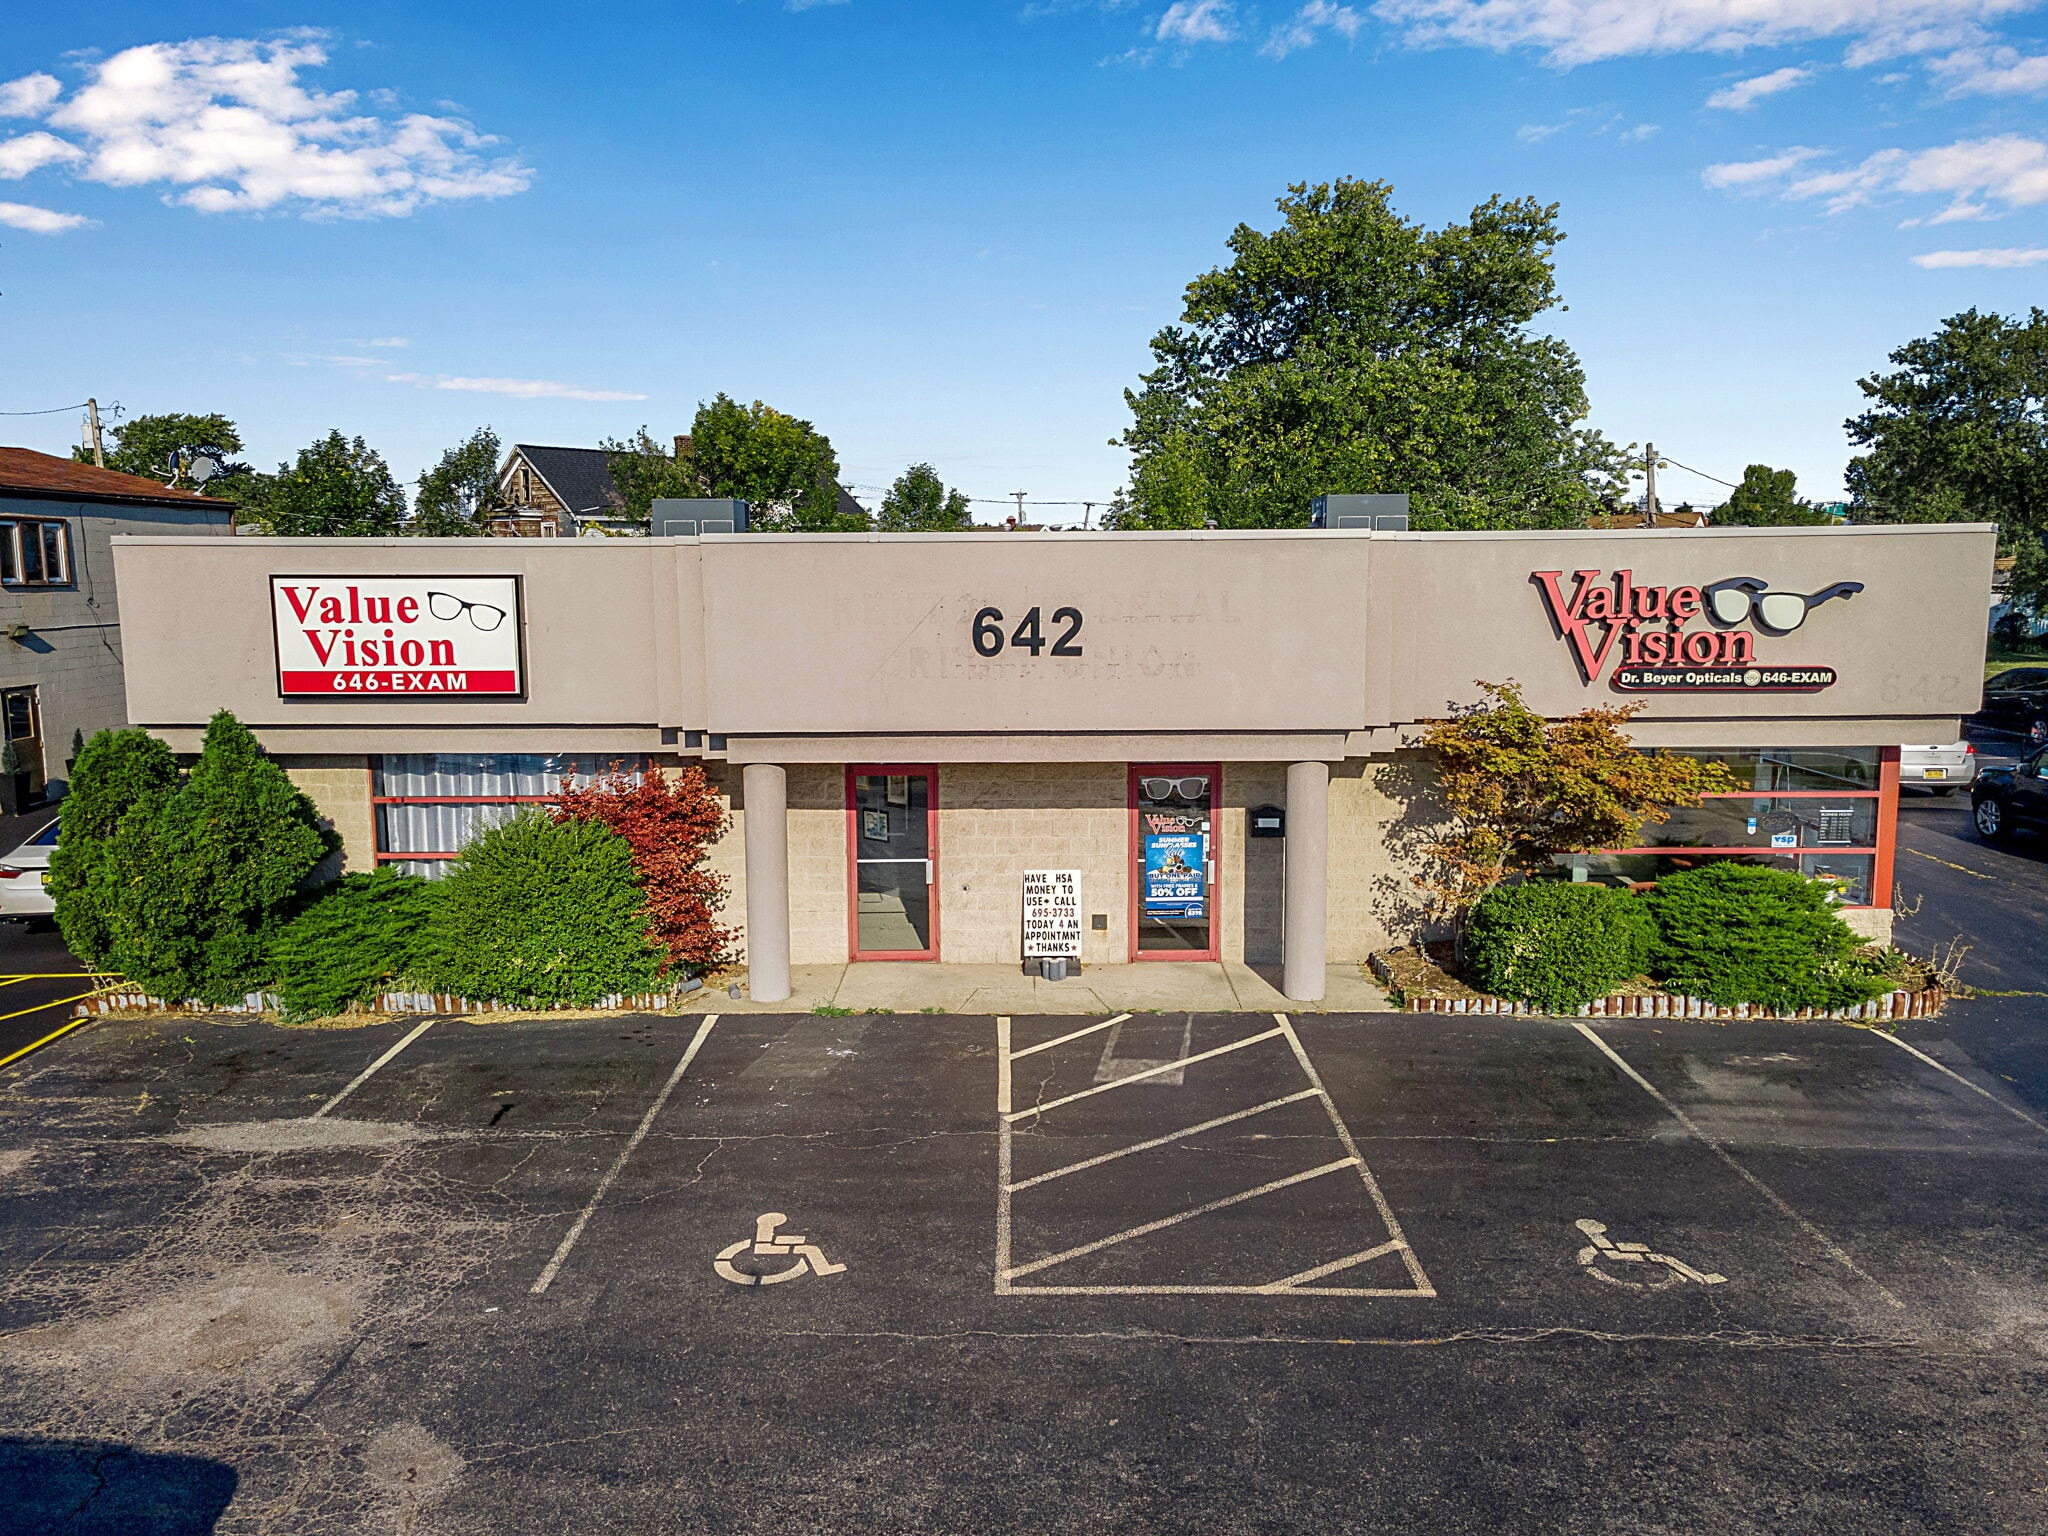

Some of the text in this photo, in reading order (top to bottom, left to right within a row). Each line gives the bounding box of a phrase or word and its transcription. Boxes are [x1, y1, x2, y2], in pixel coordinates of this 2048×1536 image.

[280, 586, 419, 625] Value
[1535, 569, 1702, 634] Value
[972, 605, 1084, 657] 642
[302, 628, 458, 667] Vision
[1570, 617, 1757, 682] Vision
[332, 672, 468, 691] 646-EXAM
[1621, 671, 1833, 686] Dr. Beyer Opticals 646-EXAM
[1774, 836, 1795, 844] vsp
[1024, 873, 1072, 884] HAVE HSA
[1026, 885, 1073, 895] MONEY TO
[1151, 887, 1198, 897] 50% OFF
[1054, 896, 1077, 906] CALL
[1031, 908, 1075, 918] 695-3733
[1026, 920, 1079, 929] TODAY 4 AN
[1025, 931, 1081, 941] APPOINTMNT
[1036, 942, 1070, 952] THANKS
